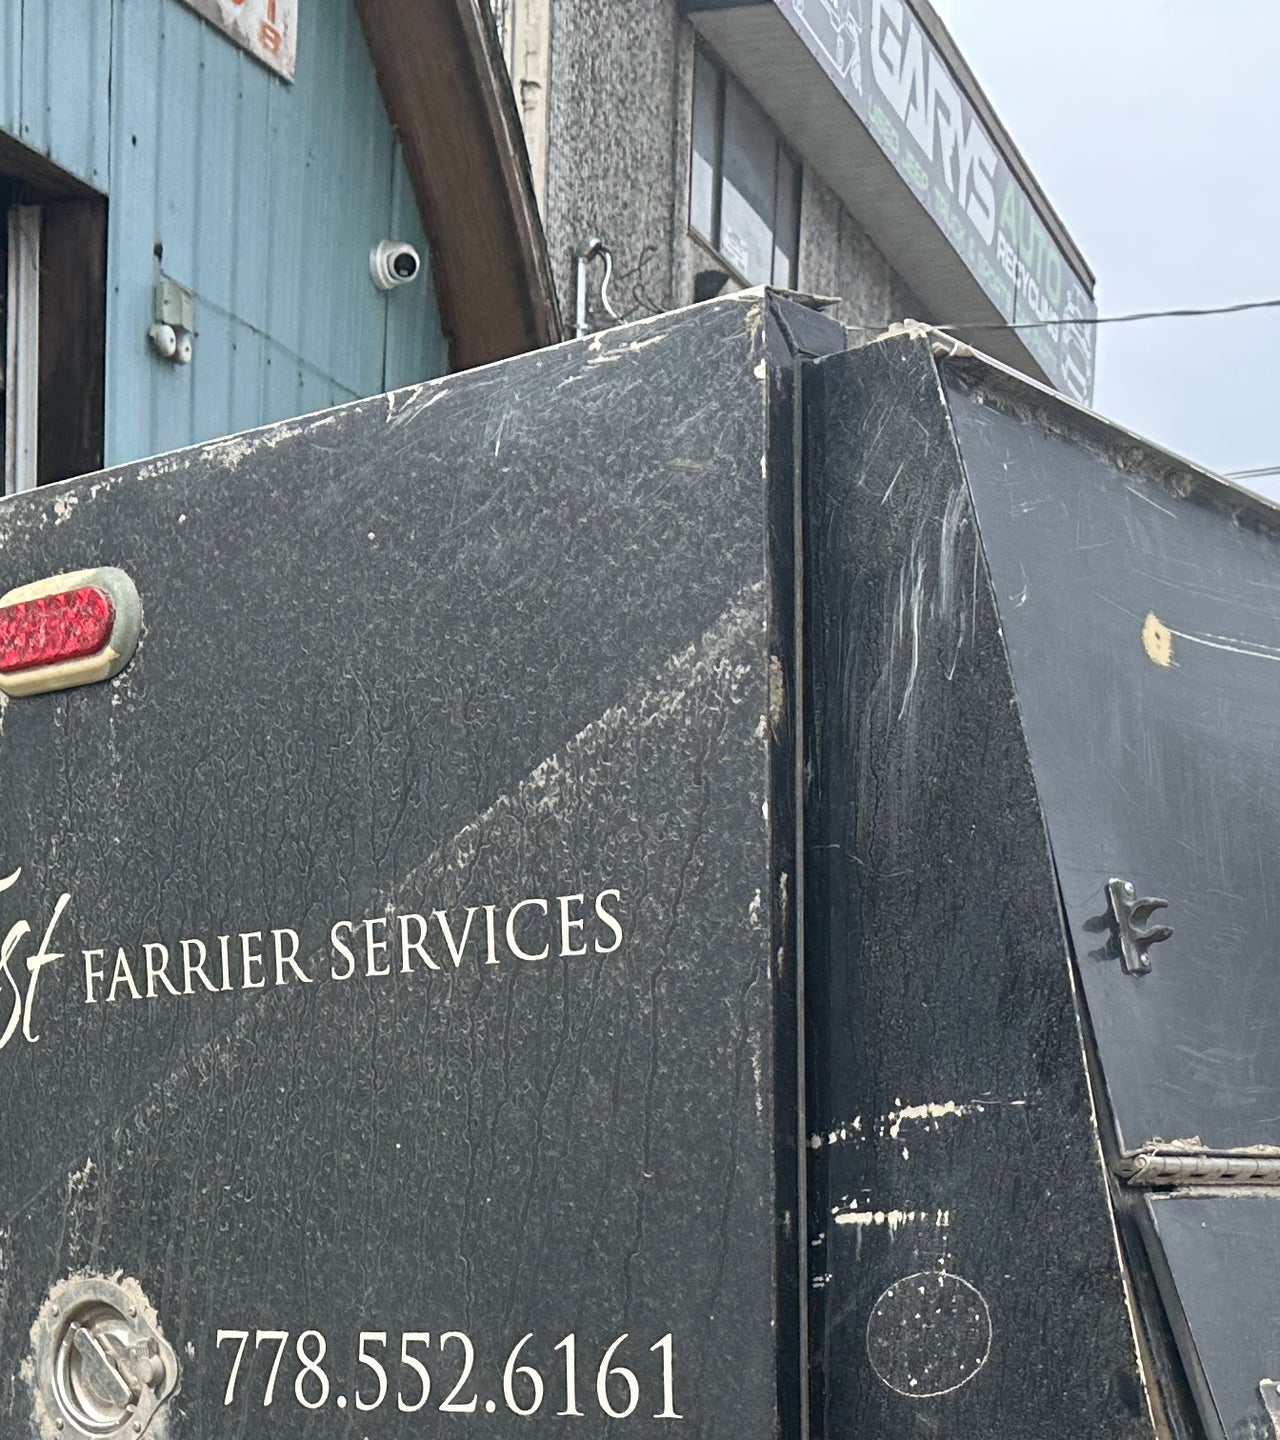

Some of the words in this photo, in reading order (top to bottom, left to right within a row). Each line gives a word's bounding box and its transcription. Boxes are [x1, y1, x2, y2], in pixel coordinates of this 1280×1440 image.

[871, 0, 998, 246] GARYS
[998, 178, 1062, 308] AUTO
[81, 933, 314, 1004] FARRIER
[329, 888, 624, 982] SERVICES
[216, 1329, 685, 1420] 778.552.6161
